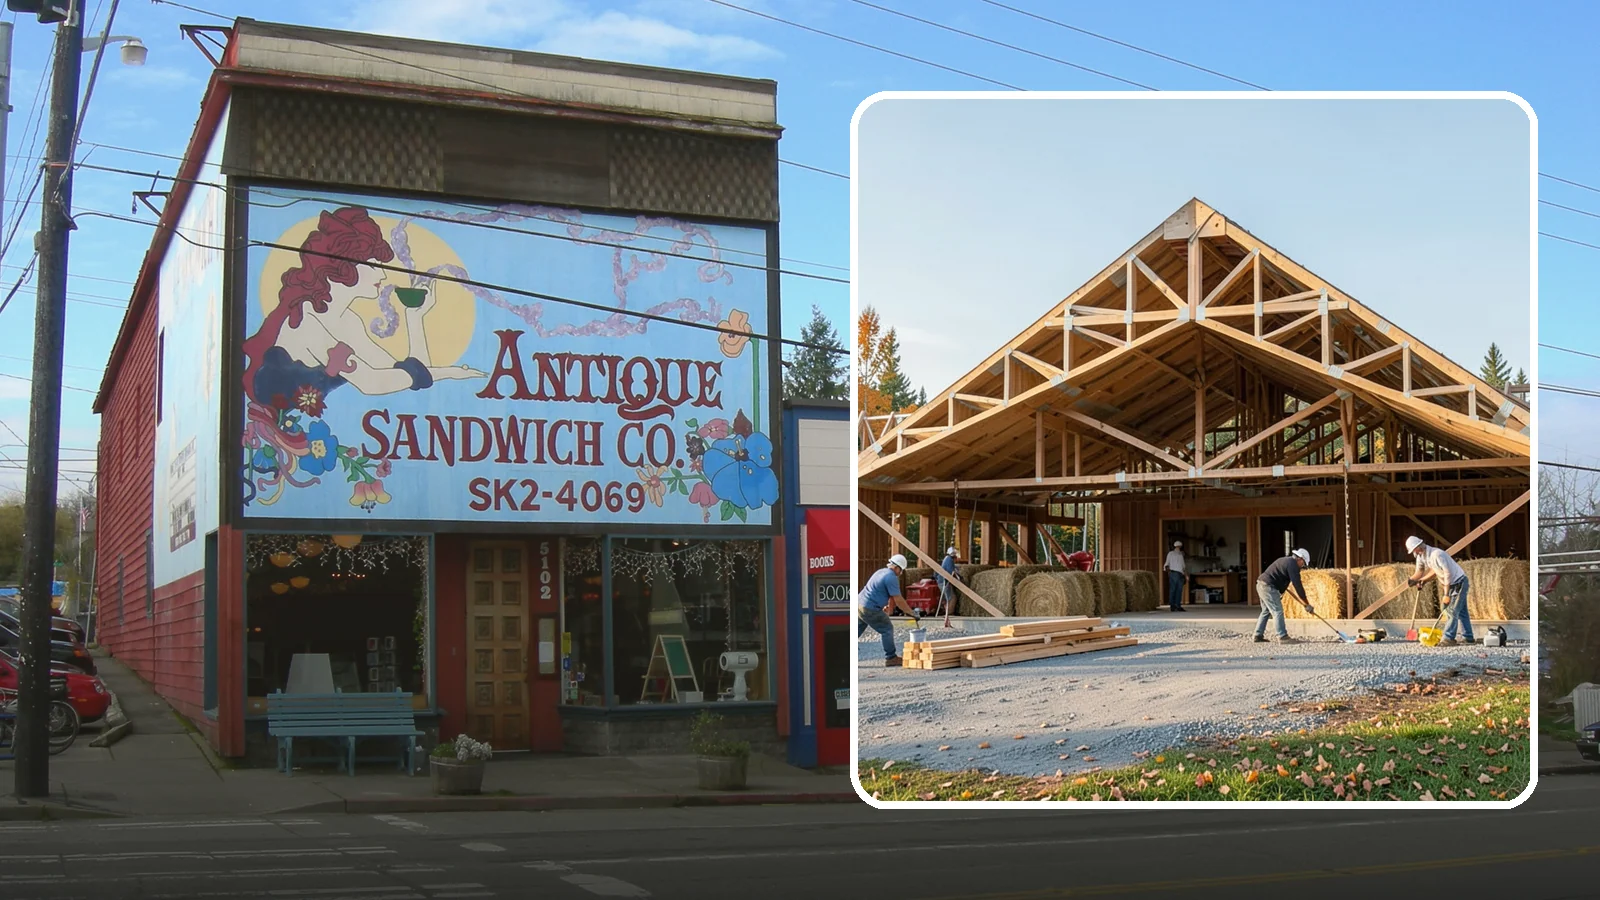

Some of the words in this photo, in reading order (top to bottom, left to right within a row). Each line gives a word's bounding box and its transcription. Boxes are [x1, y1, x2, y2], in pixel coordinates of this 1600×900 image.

[476, 329, 723, 421] ANTIQUE
[361, 409, 604, 467] SANDWICH
[617, 422, 685, 469] CO.
[468, 477, 645, 513] SK2-4069
[539, 543, 551, 599] 5102
[809, 555, 834, 568] BOOKS
